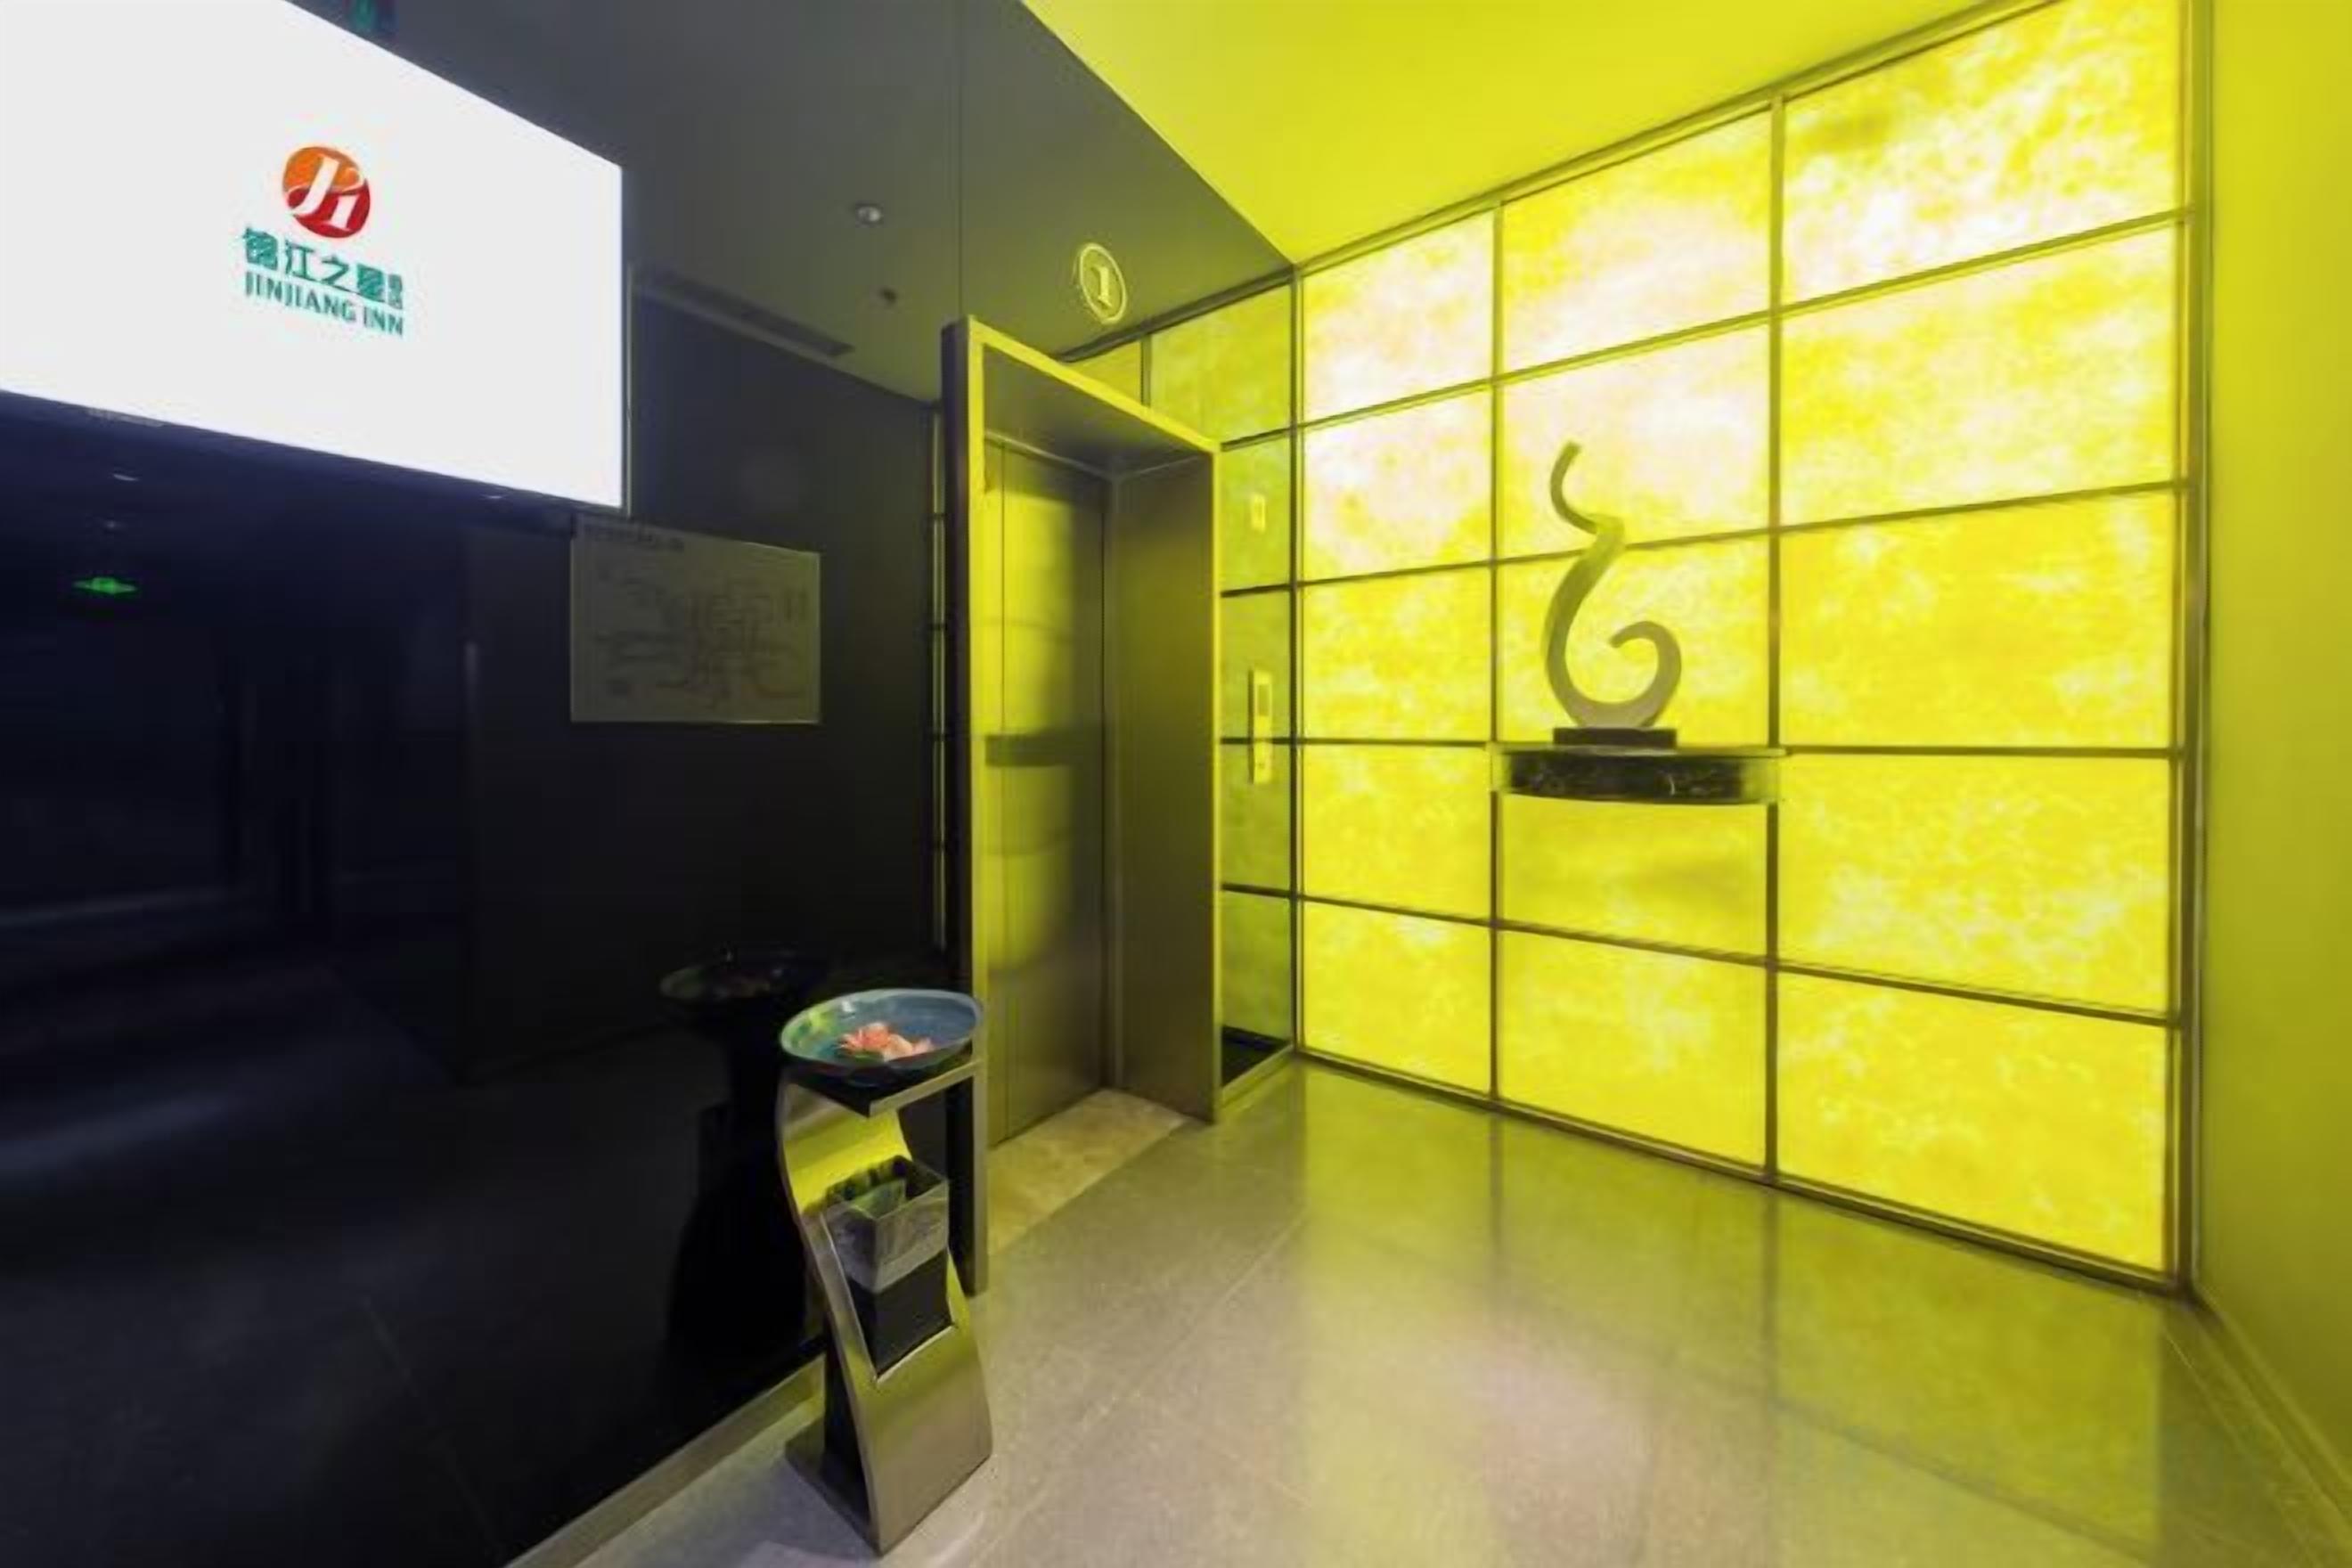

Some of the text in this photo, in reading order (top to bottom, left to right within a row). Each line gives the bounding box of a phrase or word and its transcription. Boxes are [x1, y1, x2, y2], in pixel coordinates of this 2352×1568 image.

[245, 271, 355, 323] JINJIANG
[363, 306, 403, 336] INN
[1091, 265, 1112, 307] 1
